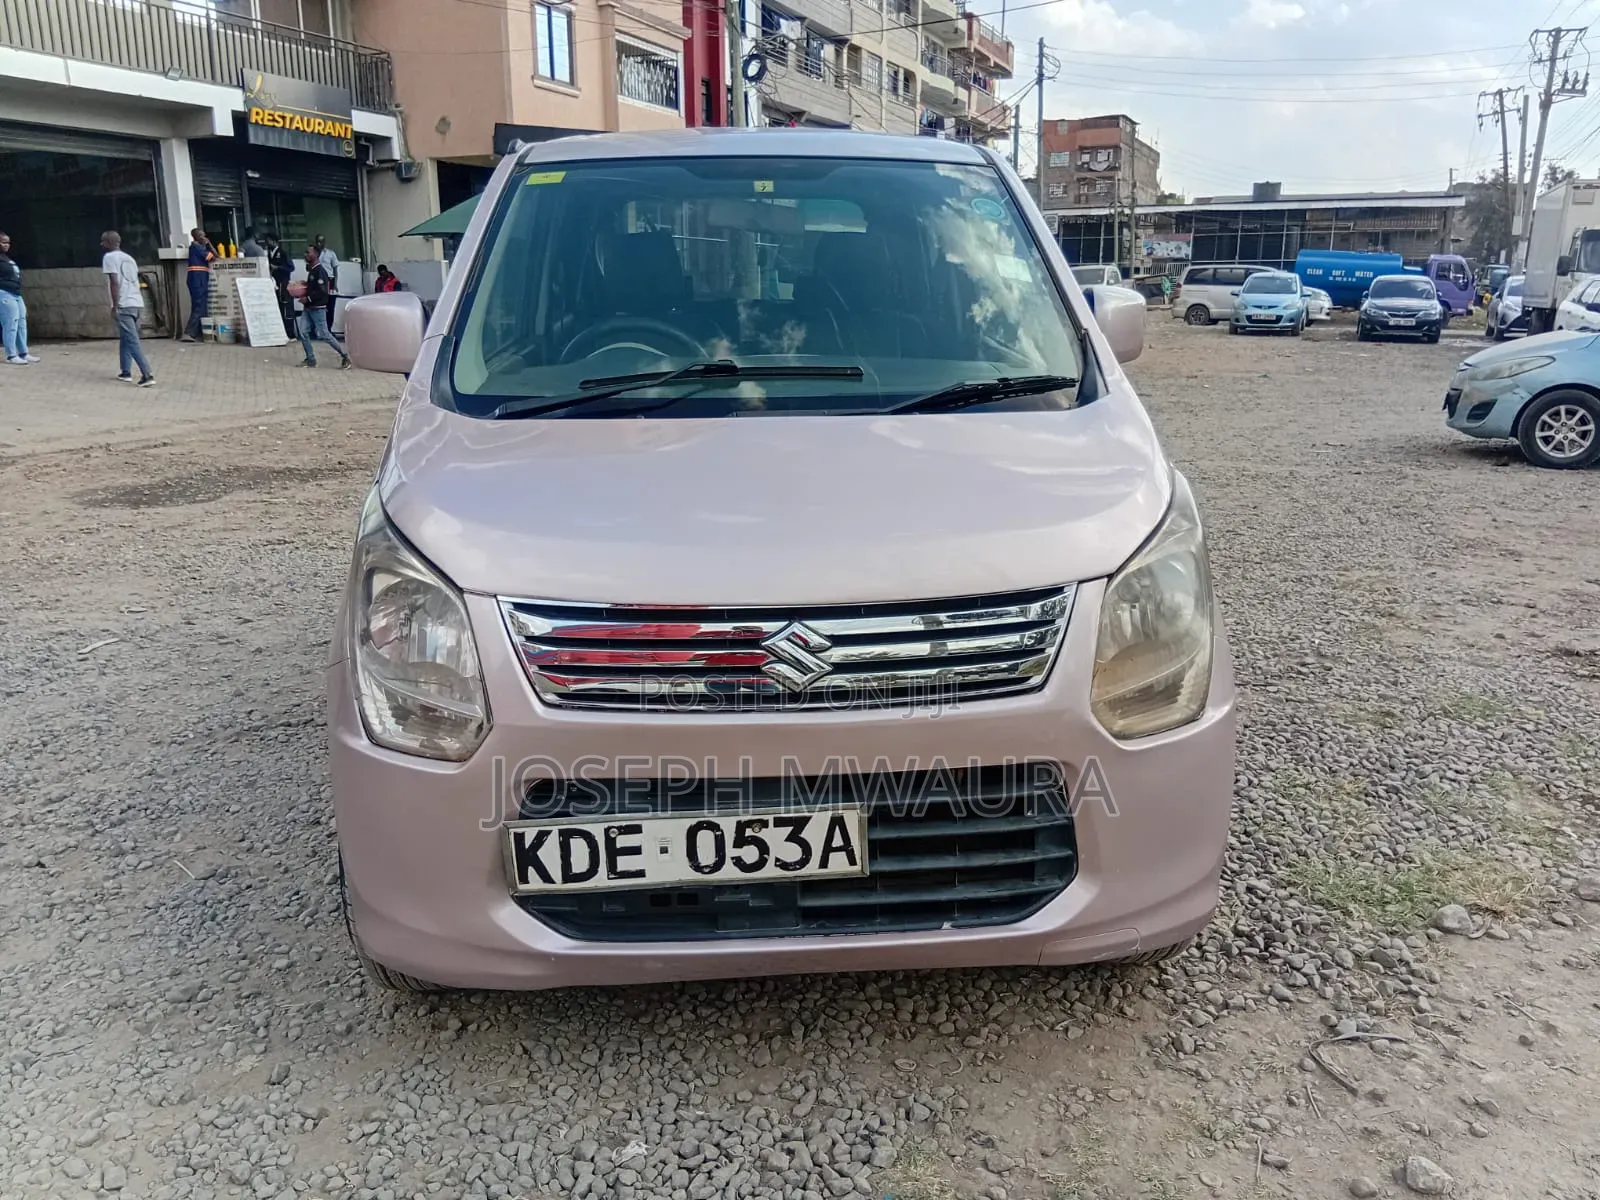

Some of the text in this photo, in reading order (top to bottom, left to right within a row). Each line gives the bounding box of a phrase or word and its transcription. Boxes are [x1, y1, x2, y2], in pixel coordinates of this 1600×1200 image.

[249, 107, 353, 139] RESTAURANT
[513, 815, 858, 885] KDE 053A
